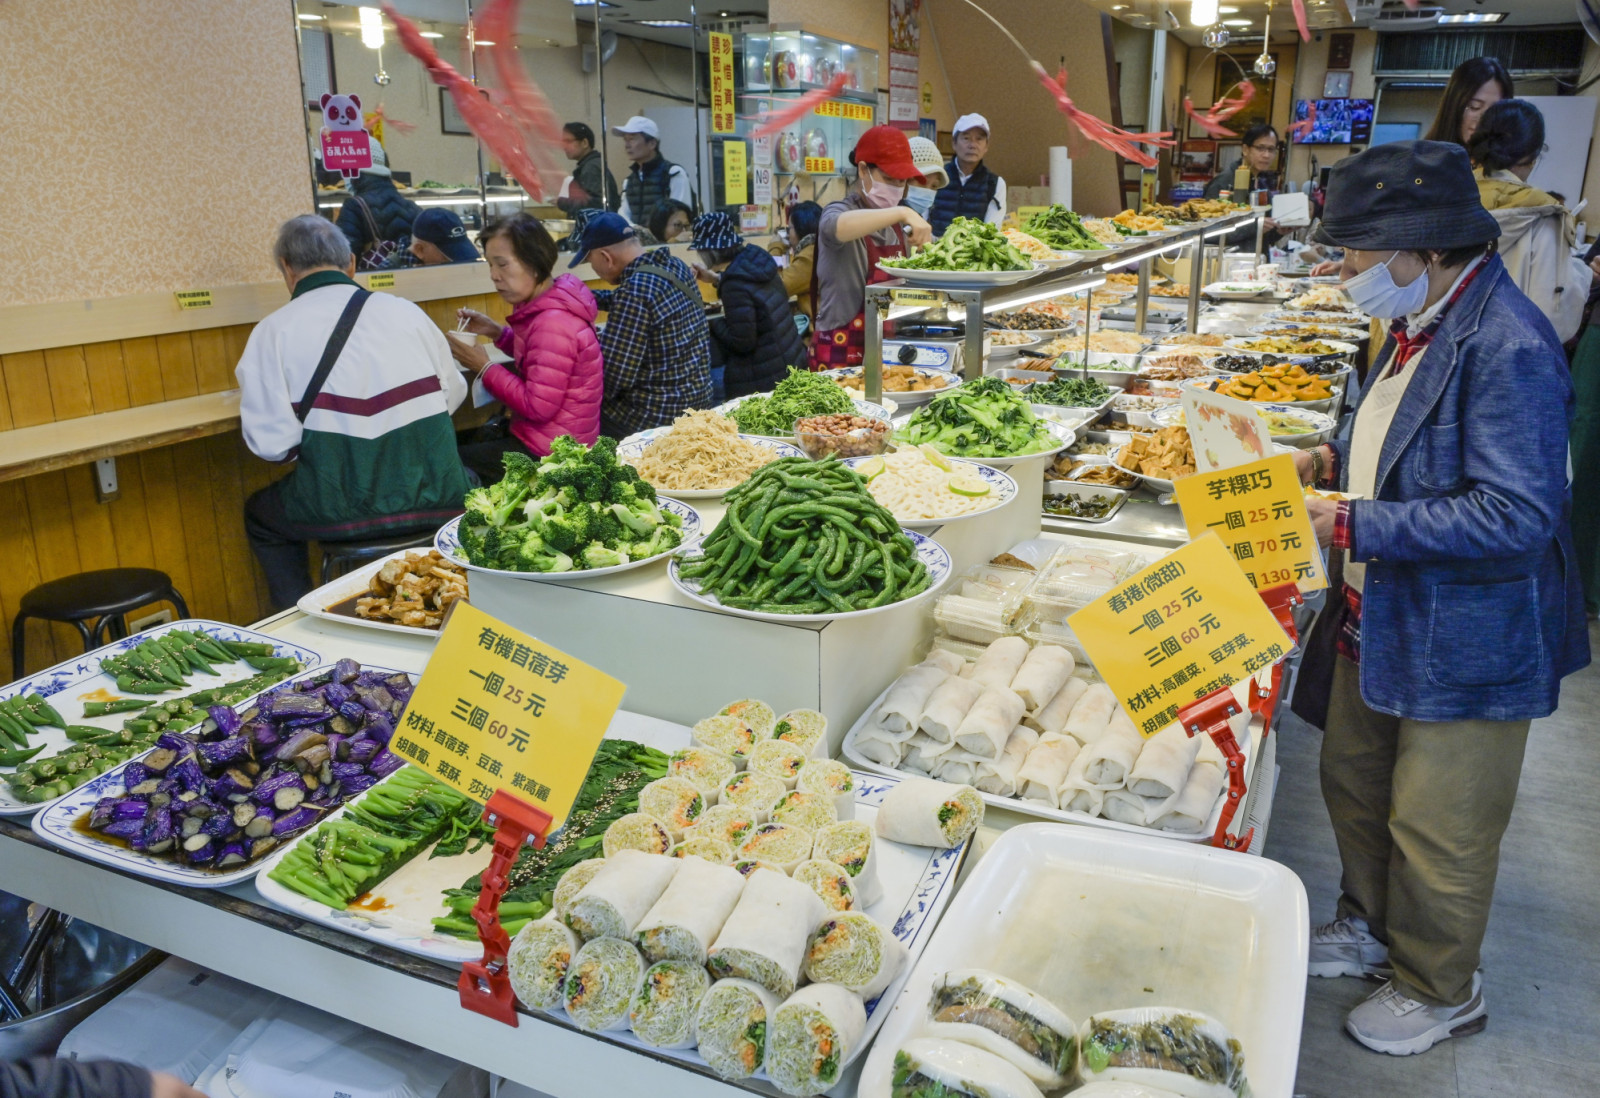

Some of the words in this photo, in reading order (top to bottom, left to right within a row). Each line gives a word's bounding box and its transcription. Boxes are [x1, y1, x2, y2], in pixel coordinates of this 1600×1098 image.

[711, 35, 723, 132] 請節約用電
[722, 37, 734, 131] 珍惜資源
[1206, 468, 1273, 500] 芋粿巧
[1206, 509, 1246, 531] 一個
[1247, 507, 1269, 524] 25
[1271, 500, 1294, 521] 元
[1226, 541, 1255, 561] 個
[1256, 538, 1278, 554] 70
[1280, 531, 1302, 551] 元
[1107, 560, 1186, 615] 春捲(微甜)
[1260, 568, 1291, 585] 130
[1293, 561, 1316, 581] 元
[1128, 608, 1165, 636] 一個
[1162, 599, 1182, 618] 25
[1180, 586, 1203, 608] 元
[478, 626, 570, 685] 有機苜蓿芽
[1143, 635, 1183, 668] 三個
[1180, 626, 1200, 645] 60
[1198, 612, 1222, 635] 元
[1242, 642, 1284, 675] 花生粉
[468, 669, 506, 697] 一個
[503, 684, 525, 705] 25
[523, 692, 547, 718] 元
[450, 697, 490, 732] 三個
[488, 720, 508, 739] 60
[507, 727, 531, 753] 元
[510, 771, 552, 803] 紫高麗
